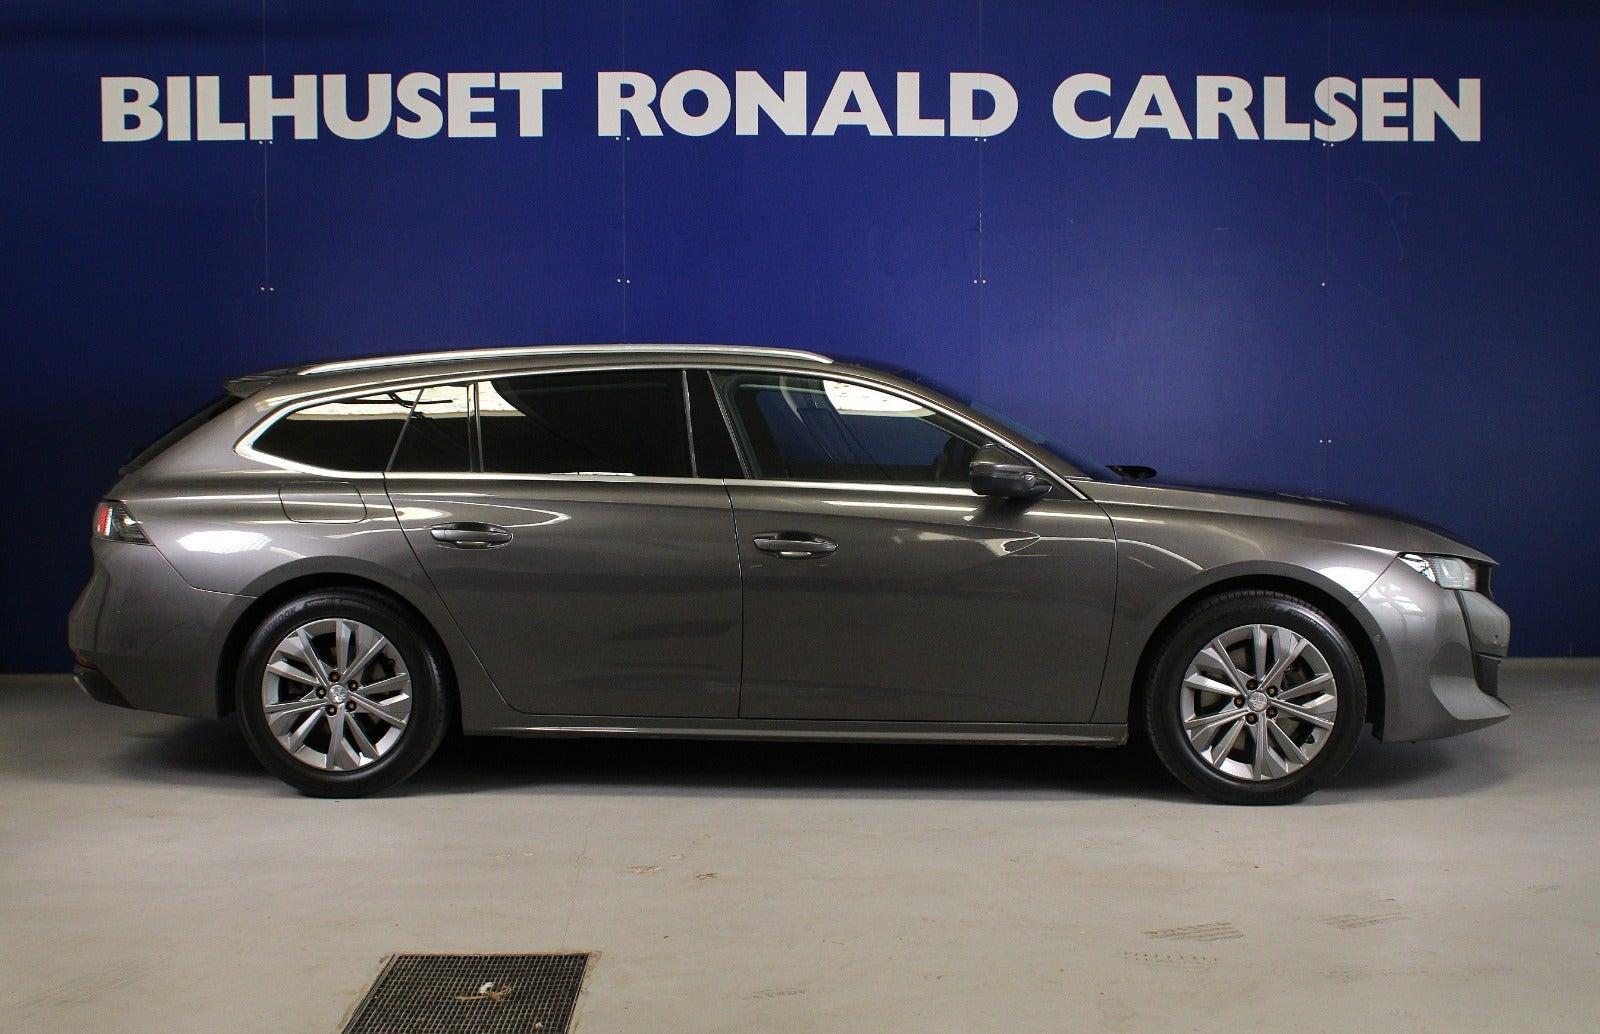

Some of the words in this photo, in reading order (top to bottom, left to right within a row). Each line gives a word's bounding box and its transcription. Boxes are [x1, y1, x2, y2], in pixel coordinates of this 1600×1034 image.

[101, 72, 562, 142] BILHUSET
[598, 70, 1018, 138] RONALD
[1053, 73, 1480, 143] CARLSEN
